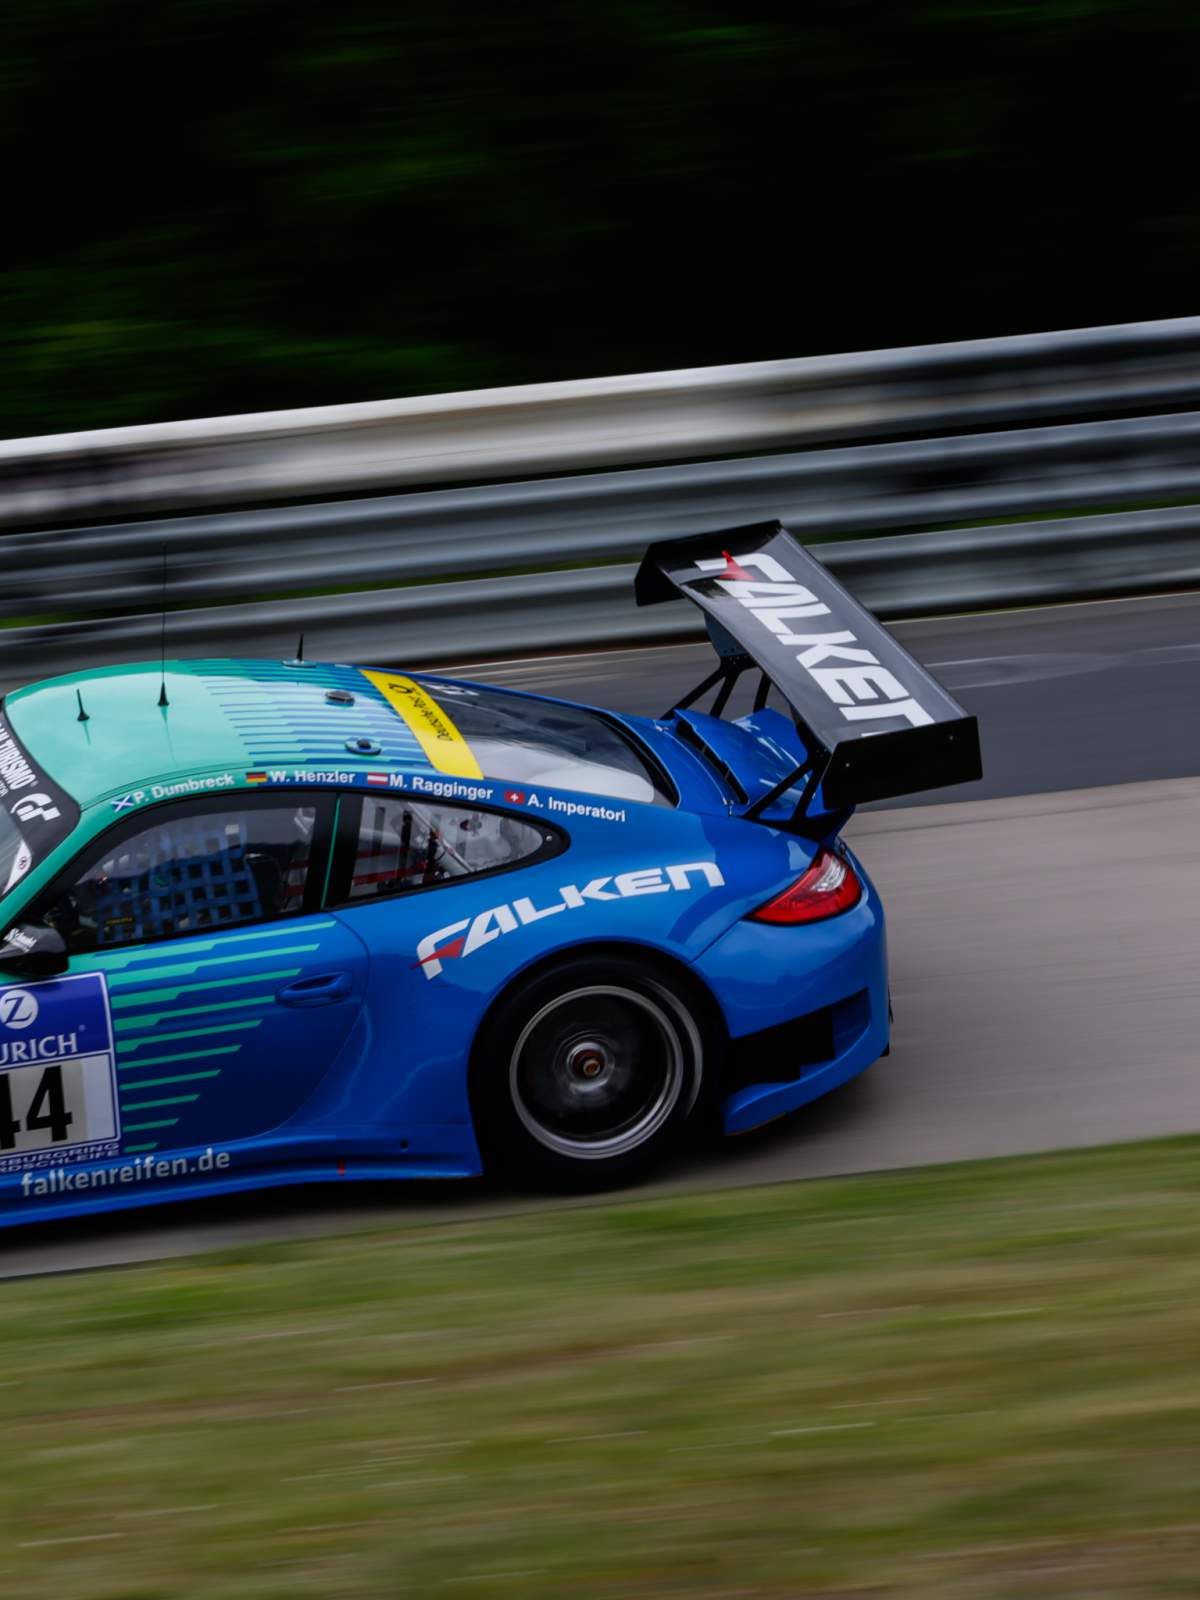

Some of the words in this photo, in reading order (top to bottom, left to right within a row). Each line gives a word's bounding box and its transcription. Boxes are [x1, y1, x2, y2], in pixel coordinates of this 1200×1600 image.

[133, 790, 149, 804] P.
[152, 774, 235, 797] Dumbreck
[271, 770, 290, 783] W.
[295, 770, 356, 784] Henzler
[389, 774, 407, 788] M.
[413, 777, 493, 801] Ragginger
[527, 793, 544, 809] A.
[548, 797, 626, 822] Imperatori
[20, 1147, 231, 1197] falkenreifen.de
